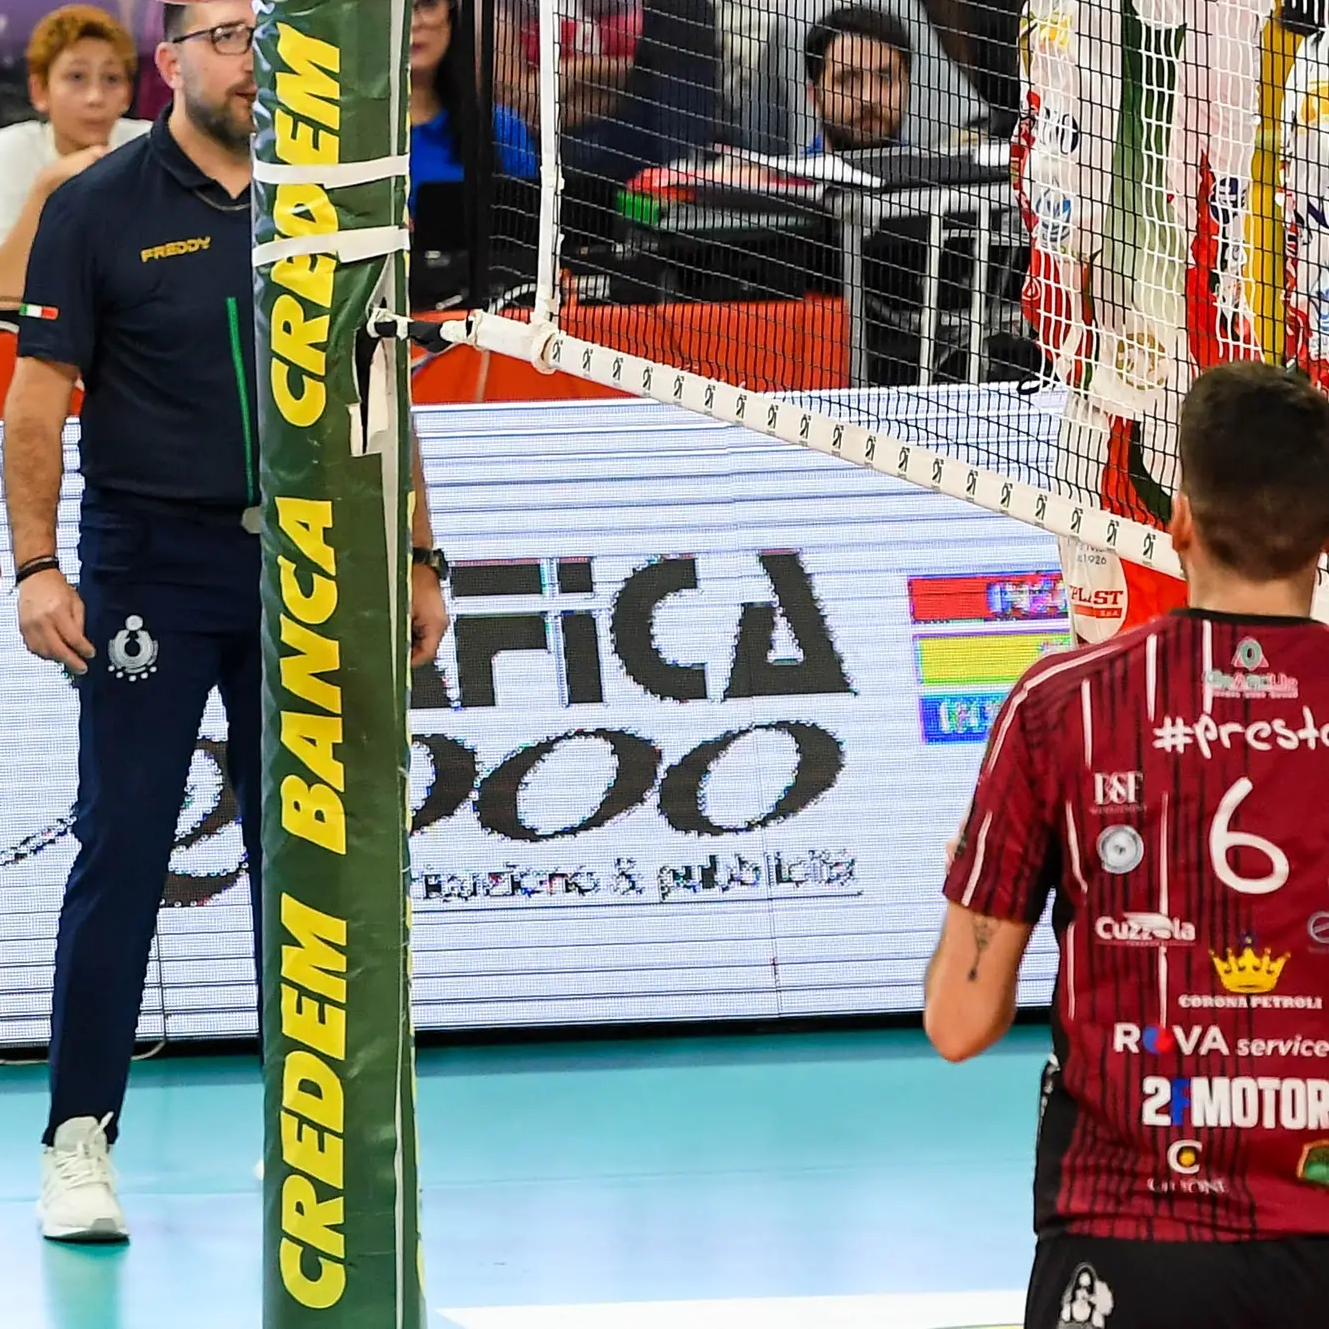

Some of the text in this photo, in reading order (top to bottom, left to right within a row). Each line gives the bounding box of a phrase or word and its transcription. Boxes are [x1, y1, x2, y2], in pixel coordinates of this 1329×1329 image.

[140, 236, 211, 262] FREDDY
[271, 22, 340, 427] CREDEM
[1209, 777, 1290, 895] 6
[275, 496, 348, 1309] CREDEM BANCA
[1178, 994, 1323, 1010] CORONA PETROLI
[1236, 1034, 1329, 1058] service
